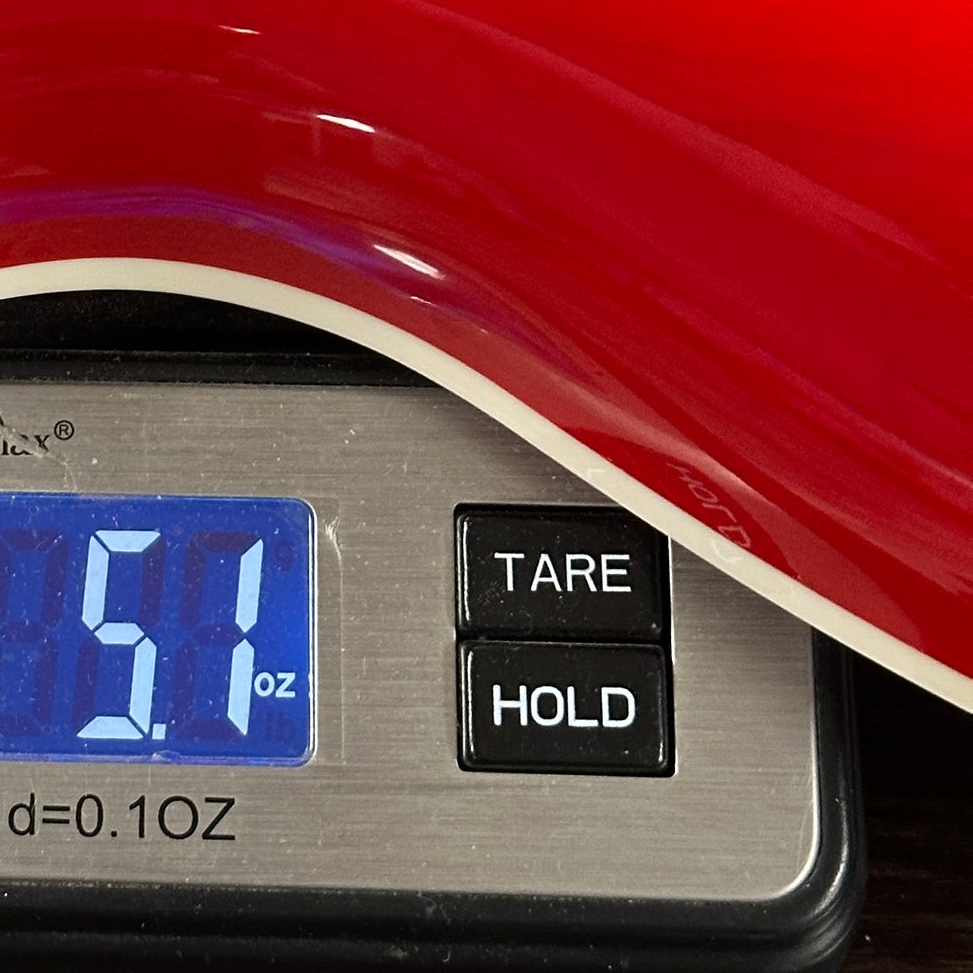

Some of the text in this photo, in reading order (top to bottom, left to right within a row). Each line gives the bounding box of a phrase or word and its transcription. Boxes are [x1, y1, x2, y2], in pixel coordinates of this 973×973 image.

[494, 553, 632, 593] TARE
[77, 530, 264, 740] 5.1
[254, 672, 296, 698] oz
[492, 685, 636, 728] HOLD
[7, 793, 236, 841] d=0.1OZ
